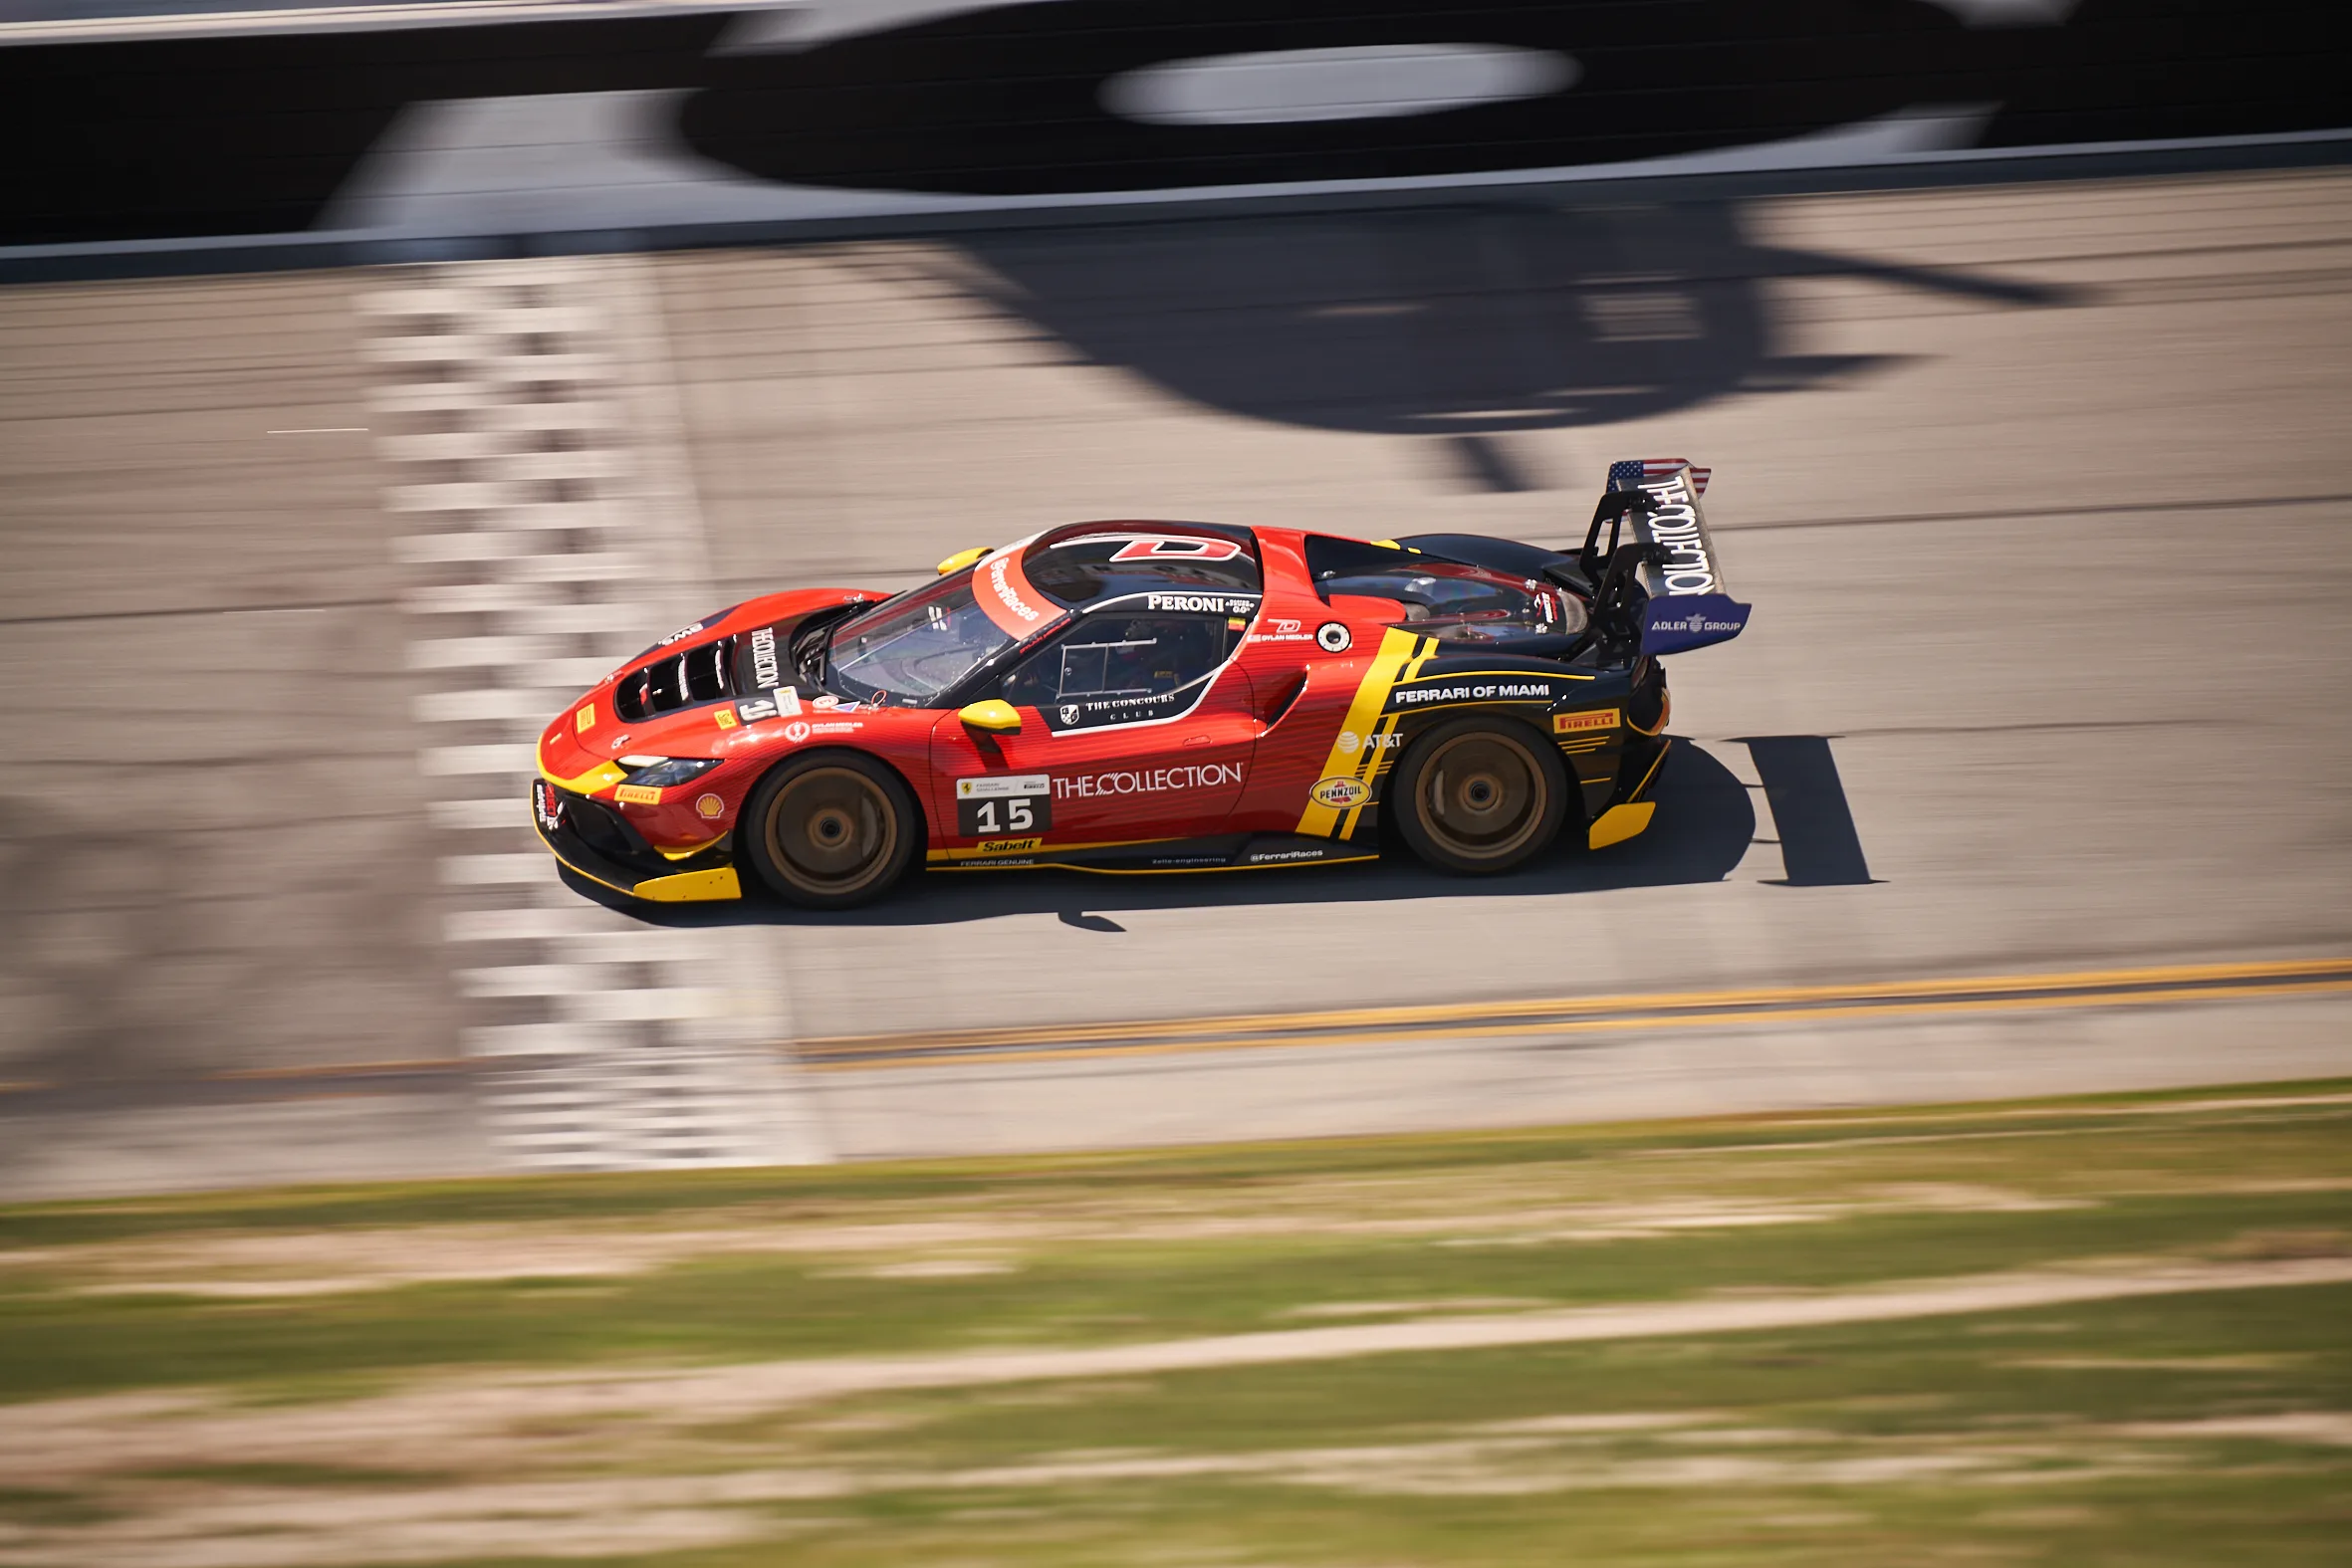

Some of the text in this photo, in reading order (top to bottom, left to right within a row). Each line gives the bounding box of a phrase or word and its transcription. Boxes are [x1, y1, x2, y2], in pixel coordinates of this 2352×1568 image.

[1147, 594, 1225, 612] PERONI
[1651, 621, 1742, 631] ADLER GROUP
[1085, 693, 1175, 712] THE CONCOURS
[1395, 684, 1549, 704] FERRARI OF MIAMI
[1559, 712, 1614, 730] PIRELLI
[1361, 733, 1404, 750] AT&T
[618, 789, 656, 801] PIRELLI
[1319, 785, 1361, 799] PENNZOIL
[977, 797, 1034, 833] 15
[983, 838, 1036, 853] Sabelt
[1250, 849, 1323, 862] @FerrariRaces
